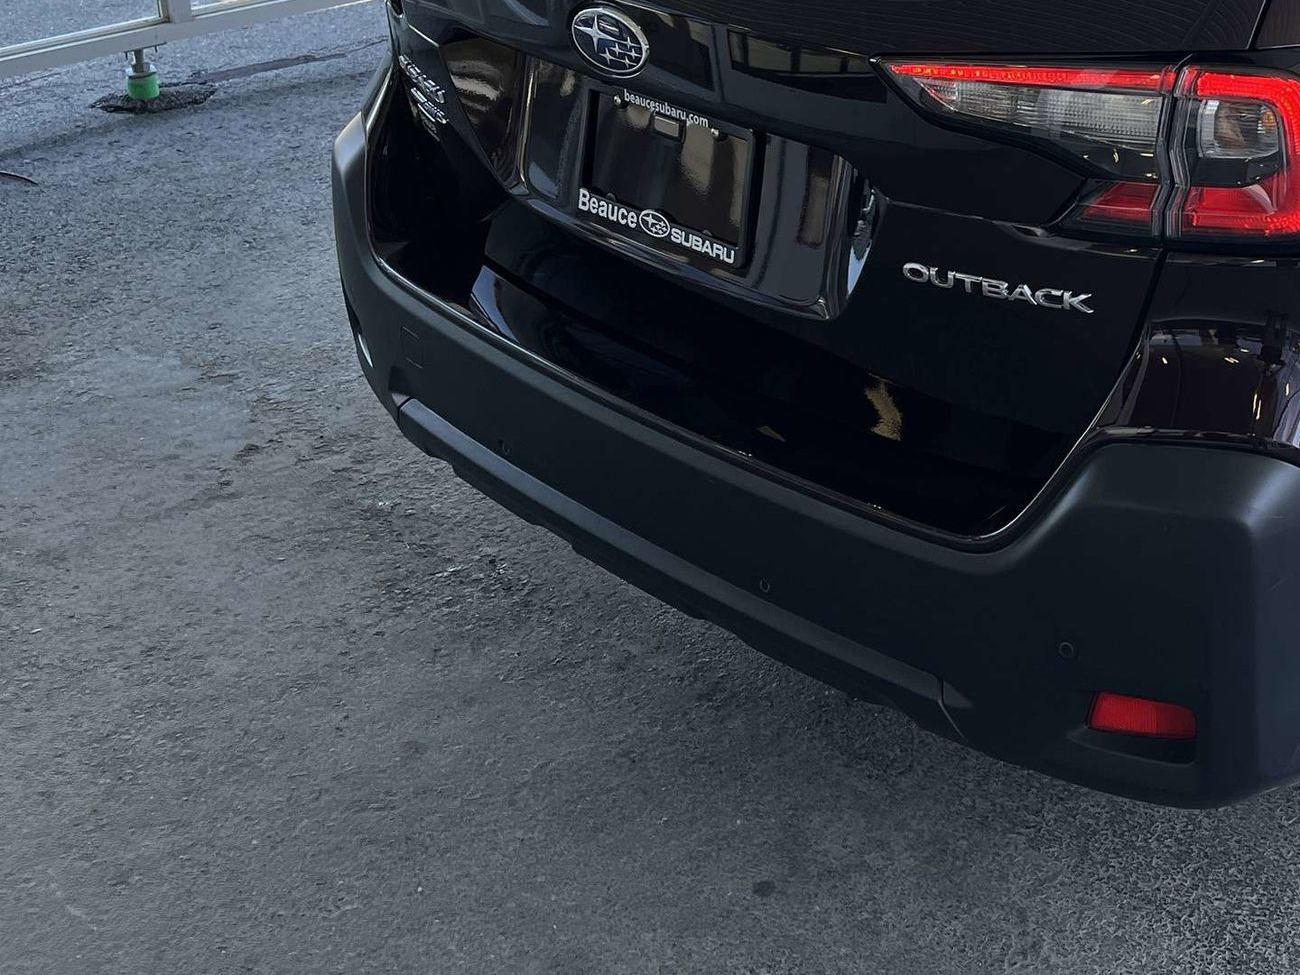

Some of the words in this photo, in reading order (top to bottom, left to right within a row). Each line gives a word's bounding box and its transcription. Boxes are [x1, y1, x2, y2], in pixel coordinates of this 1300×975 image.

[624, 88, 709, 128] beaucesubaru.com
[578, 188, 638, 229] Beauce
[670, 227, 735, 264] SUBARU
[902, 262, 1095, 313] OUTBACK
